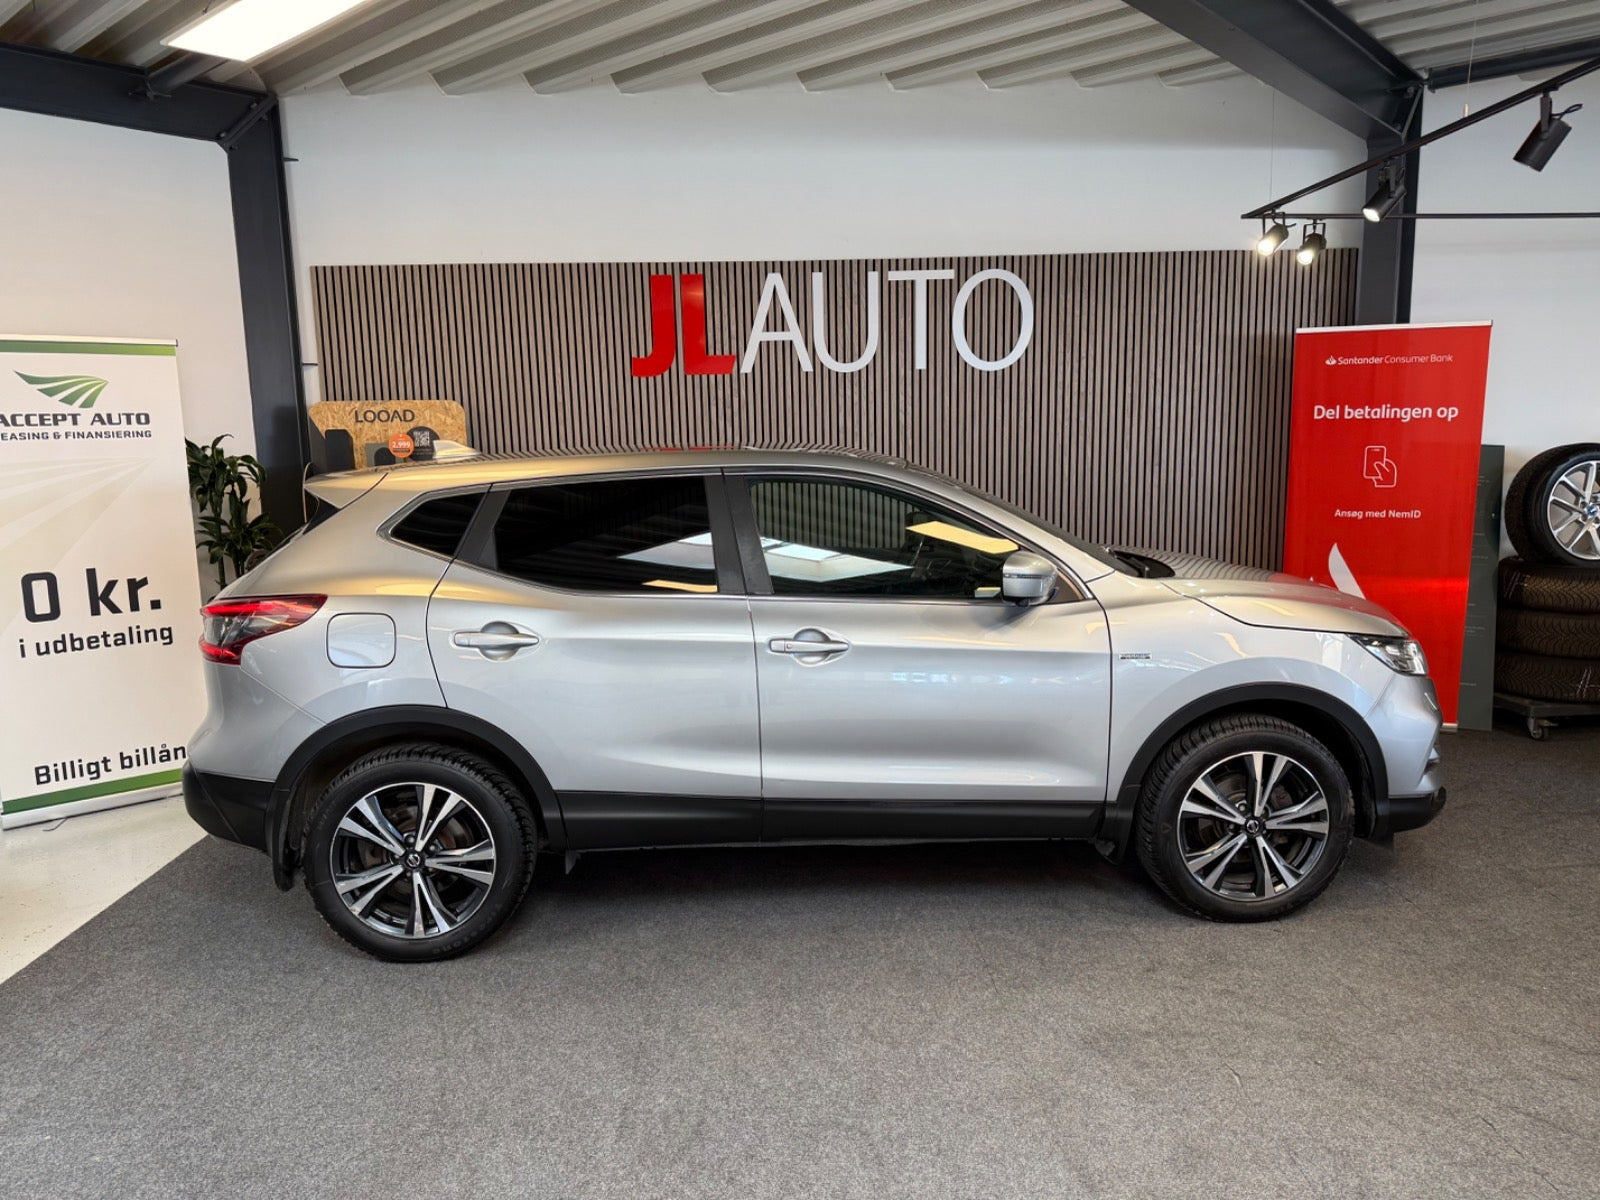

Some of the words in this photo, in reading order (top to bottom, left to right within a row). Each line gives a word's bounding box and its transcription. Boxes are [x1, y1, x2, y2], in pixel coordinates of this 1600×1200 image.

[740, 268, 1034, 373] AUTO
[1338, 356, 1383, 365] Santander
[1384, 354, 1429, 364] Consumer
[1430, 353, 1453, 362] Bank
[0, 413, 81, 427] ACCEPT
[90, 412, 150, 426] AUTO
[354, 409, 415, 423] LOOAD
[1314, 405, 1340, 419] Del
[1344, 404, 1432, 422] betalingen
[1436, 406, 1459, 421] op
[1, 432, 49, 441] EASING
[53, 431, 62, 440] &
[65, 430, 152, 439] FINANSIERING
[1334, 509, 1363, 520] Ansøg
[1365, 509, 1386, 518] med
[1388, 509, 1421, 518] NemID
[21, 572, 61, 623] 0
[86, 568, 161, 616] kr.
[19, 639, 26, 658] i
[35, 625, 173, 656] udbetaling
[35, 756, 112, 785] Billigt
[120, 743, 187, 770] billån
